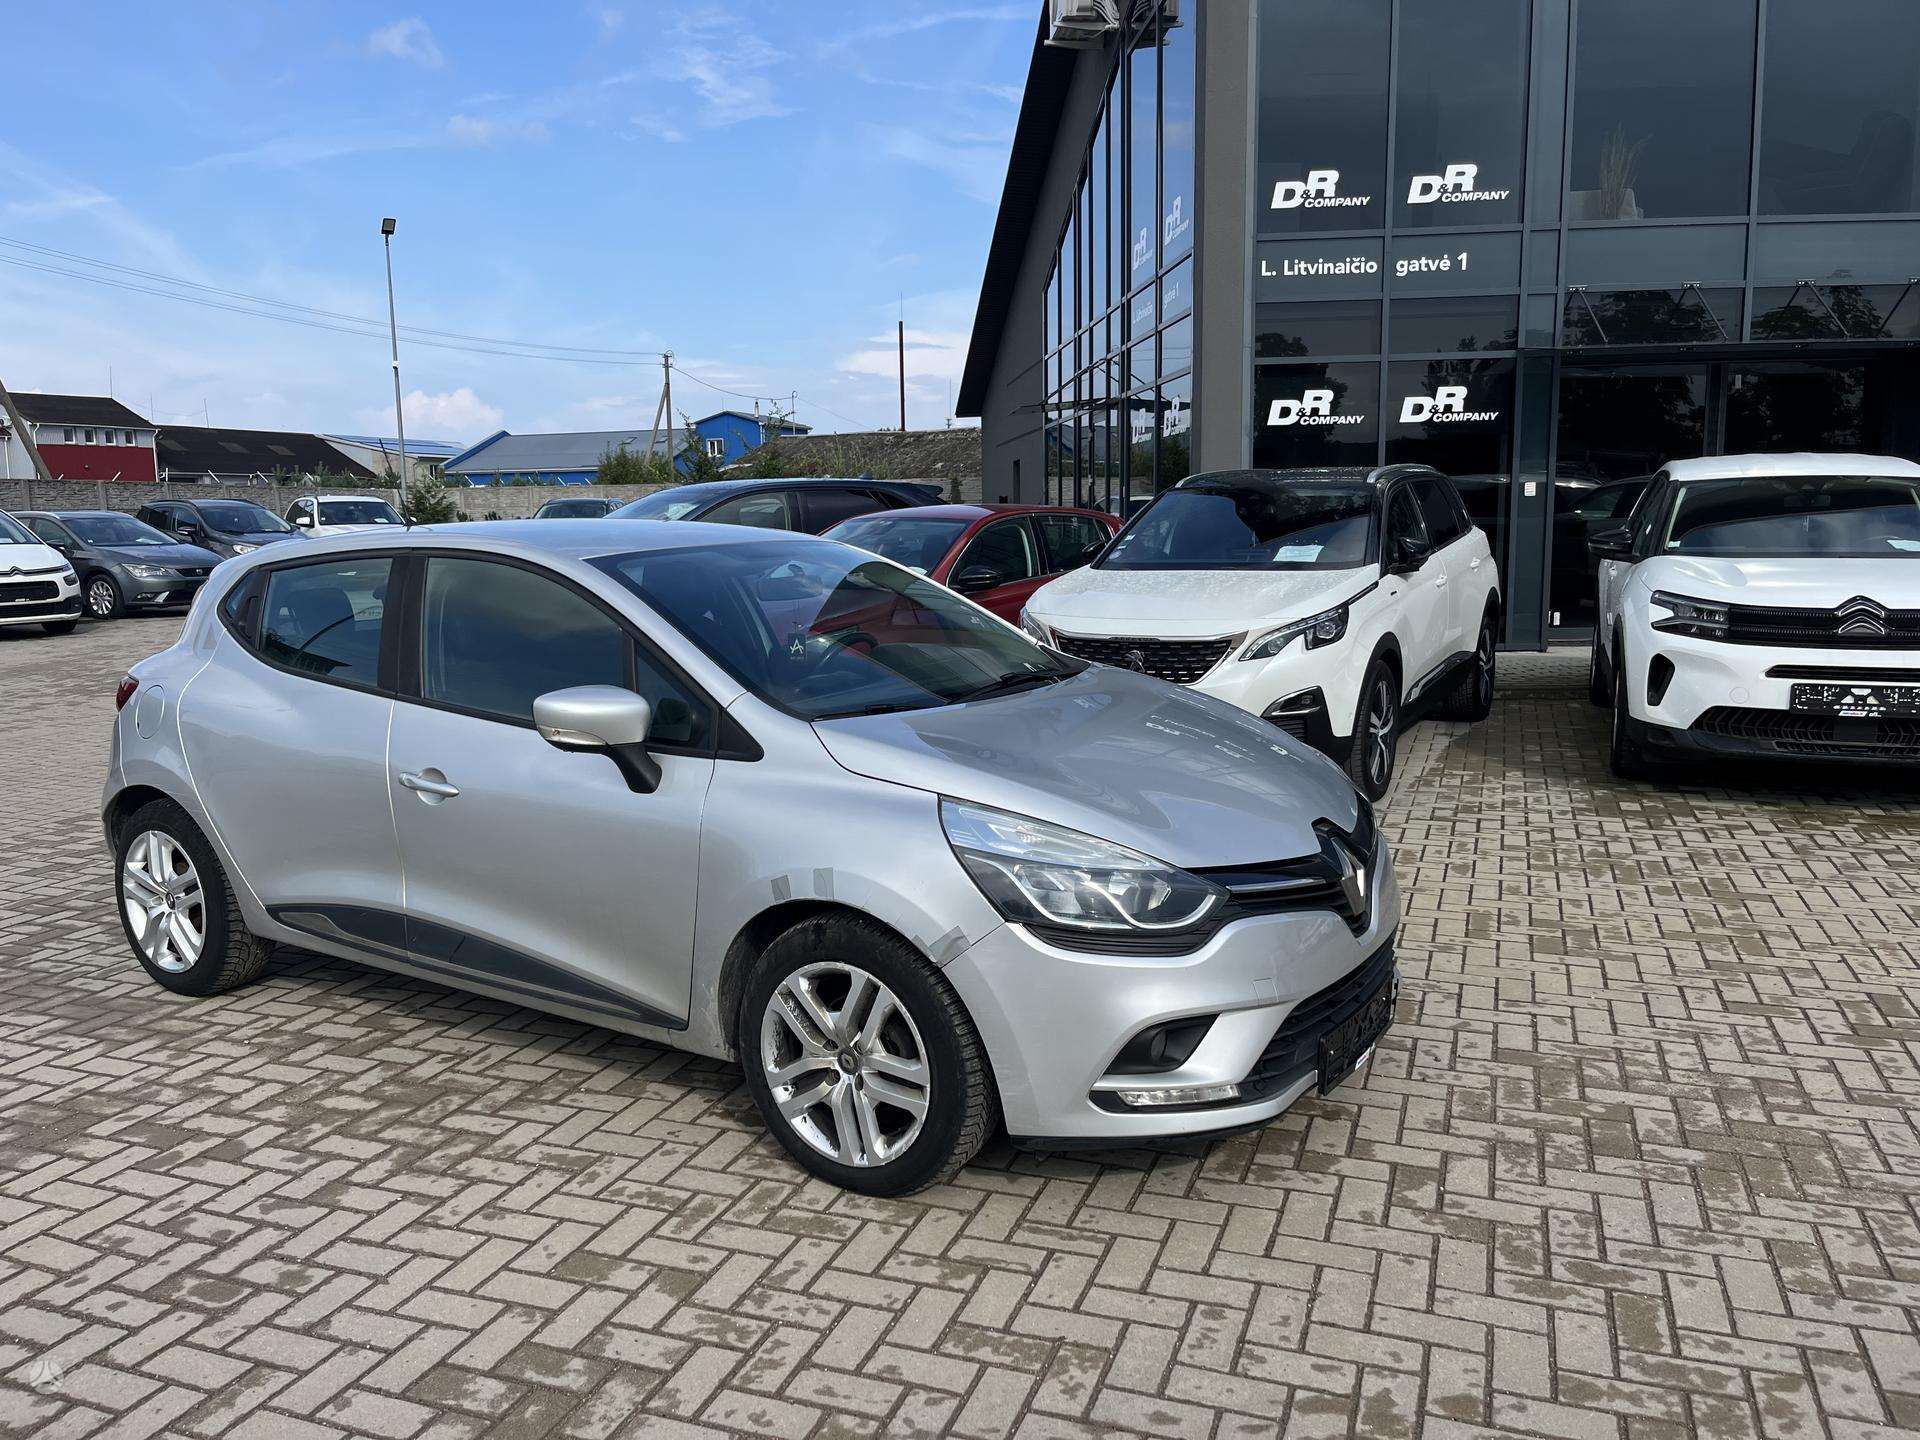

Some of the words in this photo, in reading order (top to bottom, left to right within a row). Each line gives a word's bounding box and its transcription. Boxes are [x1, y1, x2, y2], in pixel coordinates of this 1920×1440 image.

[1270, 169, 1339, 209] D&R
[1407, 164, 1478, 204] D&R
[1304, 196, 1371, 208] COMPANY
[1441, 191, 1510, 203] COMPANY
[1261, 260, 1277, 277] L.
[1283, 257, 1378, 276] Litvinaičio
[1395, 254, 1450, 277] gatvė
[1456, 252, 1468, 271] 1
[1267, 389, 1334, 426] D&R
[1399, 386, 1468, 423] D&R
[1432, 411, 1499, 422] COMPANY
[1300, 415, 1365, 426] COMPANY
